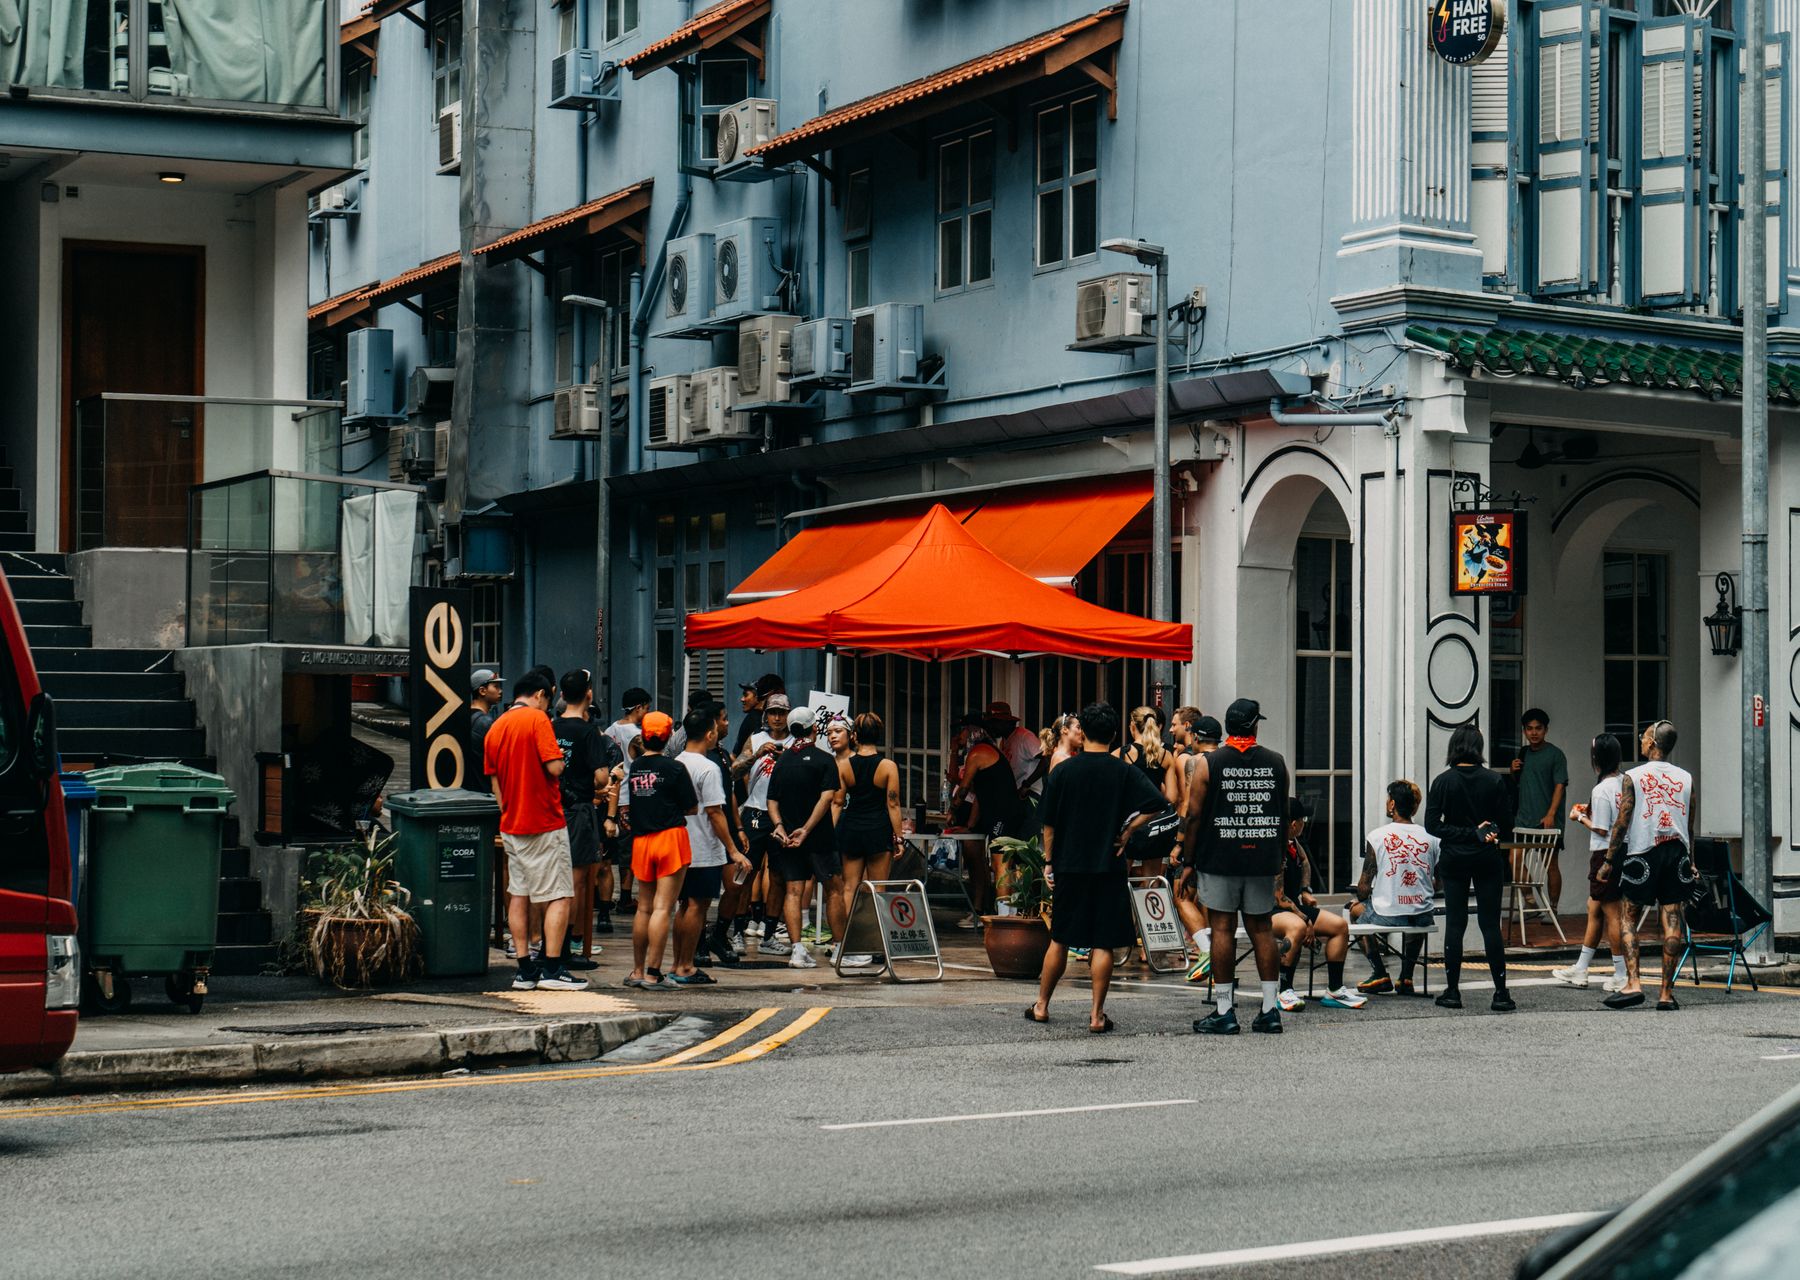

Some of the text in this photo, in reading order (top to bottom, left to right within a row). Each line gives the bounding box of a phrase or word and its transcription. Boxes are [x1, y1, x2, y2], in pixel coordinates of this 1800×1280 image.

[1453, 0, 1488, 17] HAIR
[1453, 16, 1487, 36] FREE
[1477, 33, 1486, 41] SG
[1445, 51, 1476, 62] EST 2020
[1754, 695, 1763, 726] 6F
[1222, 767, 1274, 777] GOOD SEX
[1221, 780, 1275, 790] NO STRESS
[1226, 792, 1271, 802] ONE BOO
[1234, 804, 1264, 814] NO EX
[1214, 815, 1280, 826] SMALL CIRCLE
[1219, 828, 1277, 838] BIG CHECKS
[452, 848, 475, 856] CORA
[1146, 922, 1174, 932] 禁止停车
[890, 929, 927, 940] 禁止停车
[1149, 934, 1178, 943] NO PARKING
[892, 942, 930, 952] NO PARKING
